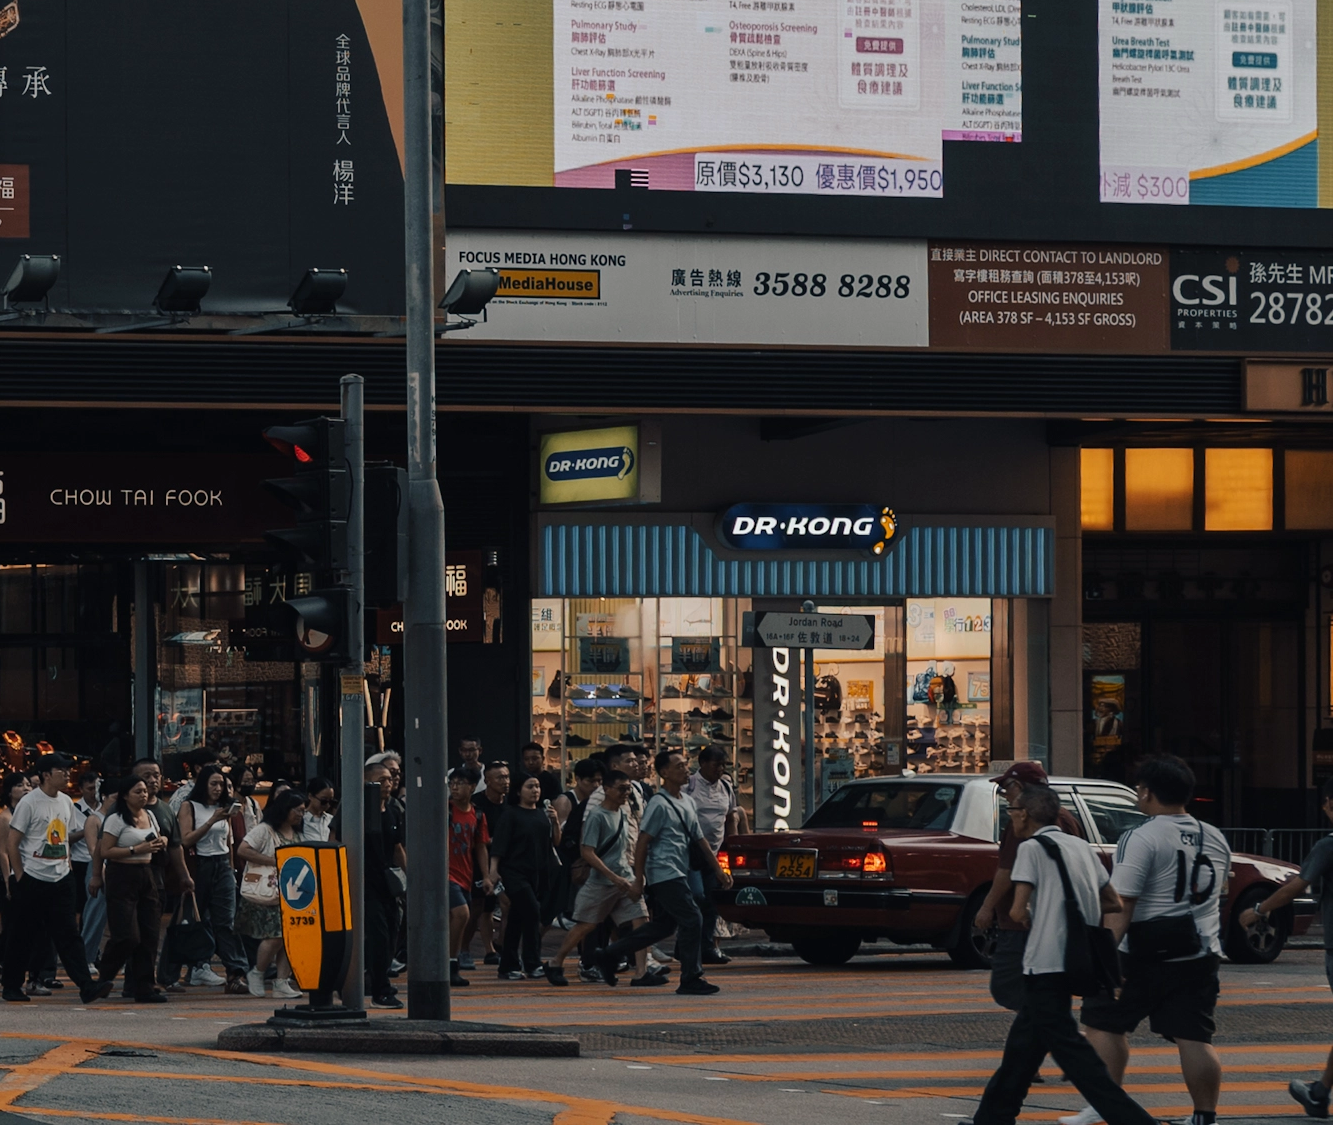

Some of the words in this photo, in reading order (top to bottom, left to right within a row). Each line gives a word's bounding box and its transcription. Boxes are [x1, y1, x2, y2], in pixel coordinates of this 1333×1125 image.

[335, 33, 352, 147] 全球品牌代言人
[332, 158, 355, 206] 楊洋
[696, 161, 804, 189] 原價$3,130
[816, 165, 943, 193] 優惠價$1,950
[459, 251, 500, 263] FOCUS
[504, 253, 546, 265] MEDIA
[550, 254, 586, 266] HONG
[590, 255, 626, 266] KONG
[980, 250, 1020, 263] DIRECT
[1023, 250, 1078, 264] CONTACT
[1080, 252, 1096, 264] TO
[1099, 252, 1162, 266] LANDLORD
[1249, 262, 1303, 284] 孫先生
[500, 276, 593, 291] MediaHouse
[671, 268, 742, 288] 廣告熱線
[753, 272, 827, 298] 3588
[838, 274, 911, 299] 8288
[670, 289, 709, 299] Advertising
[711, 289, 744, 299] Enquiries
[968, 291, 1008, 304] OFFICE
[1011, 291, 1060, 305] LEASING
[1063, 292, 1124, 306] ENQUIRIES
[959, 311, 994, 326] (AREA
[997, 312, 1018, 325] 378
[1020, 312, 1033, 325] SF
[1045, 313, 1075, 327] 4,153
[1078, 313, 1091, 326] SF
[1093, 312, 1136, 328] GROSS)
[1178, 309, 1238, 318] PROPERTIES
[49, 488, 112, 506] CHOW
[121, 489, 155, 506] TAI
[165, 489, 224, 507] FOOK
[789, 617, 818, 627] Jordan
[821, 618, 843, 628] Road
[798, 632, 833, 644] 佐敦道
[780, 865, 811, 877] 2554
[289, 915, 315, 927] 3739
